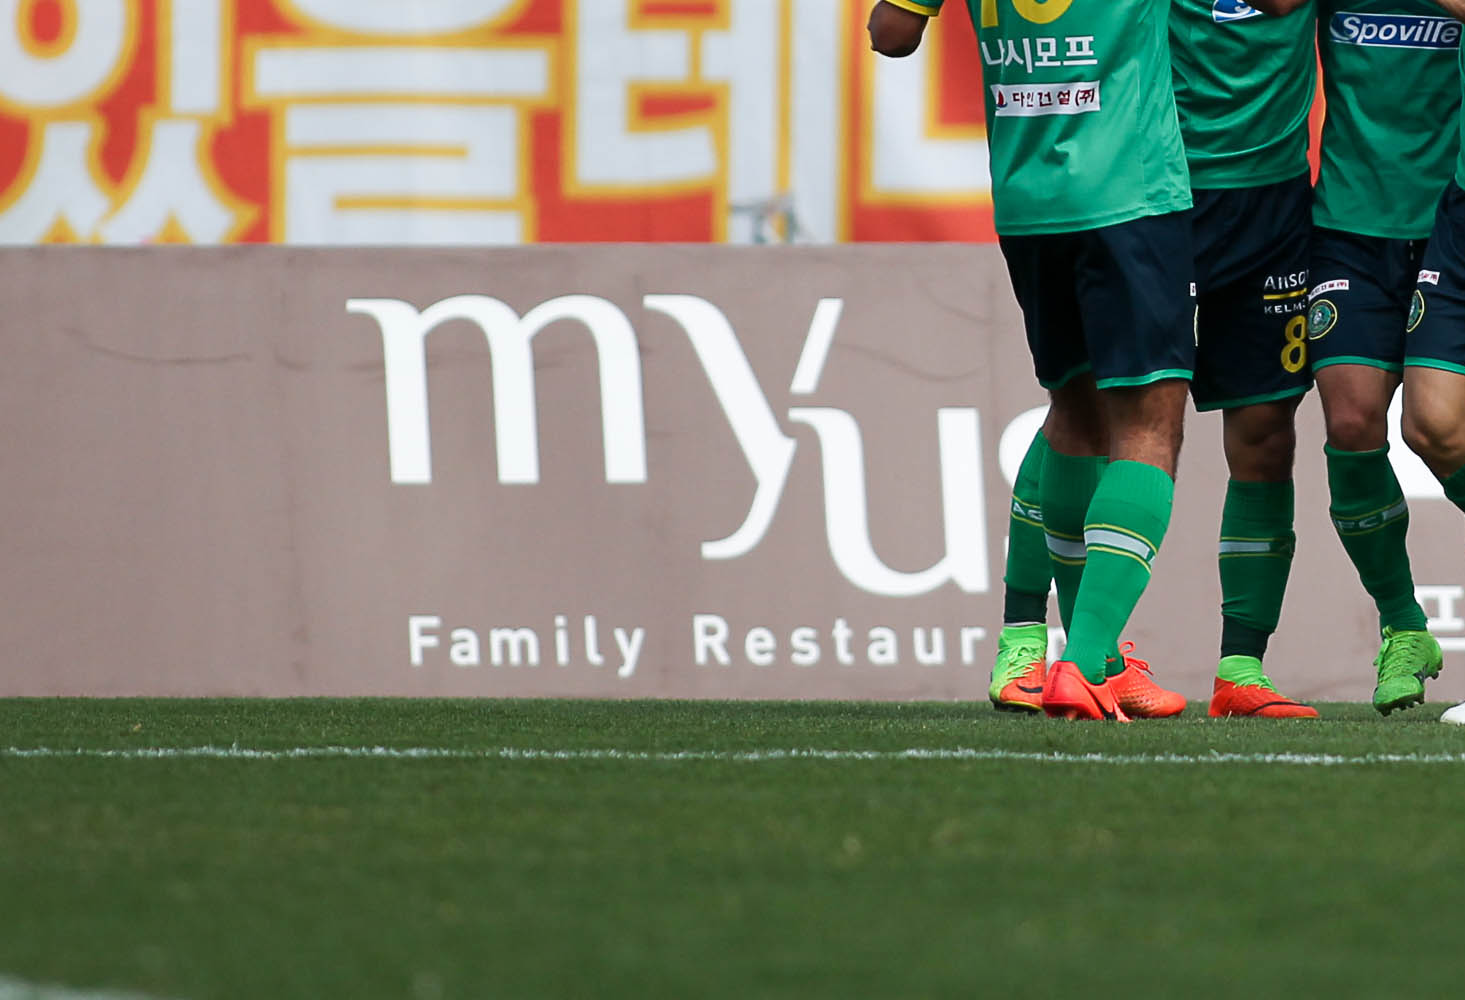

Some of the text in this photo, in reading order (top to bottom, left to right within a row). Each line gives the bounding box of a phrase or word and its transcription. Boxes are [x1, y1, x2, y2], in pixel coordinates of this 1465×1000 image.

[1342, 15, 1459, 45] Spoville
[1263, 303, 1306, 315] KELM
[1281, 314, 1306, 373] 8
[408, 614, 1066, 679] Family Restaur
